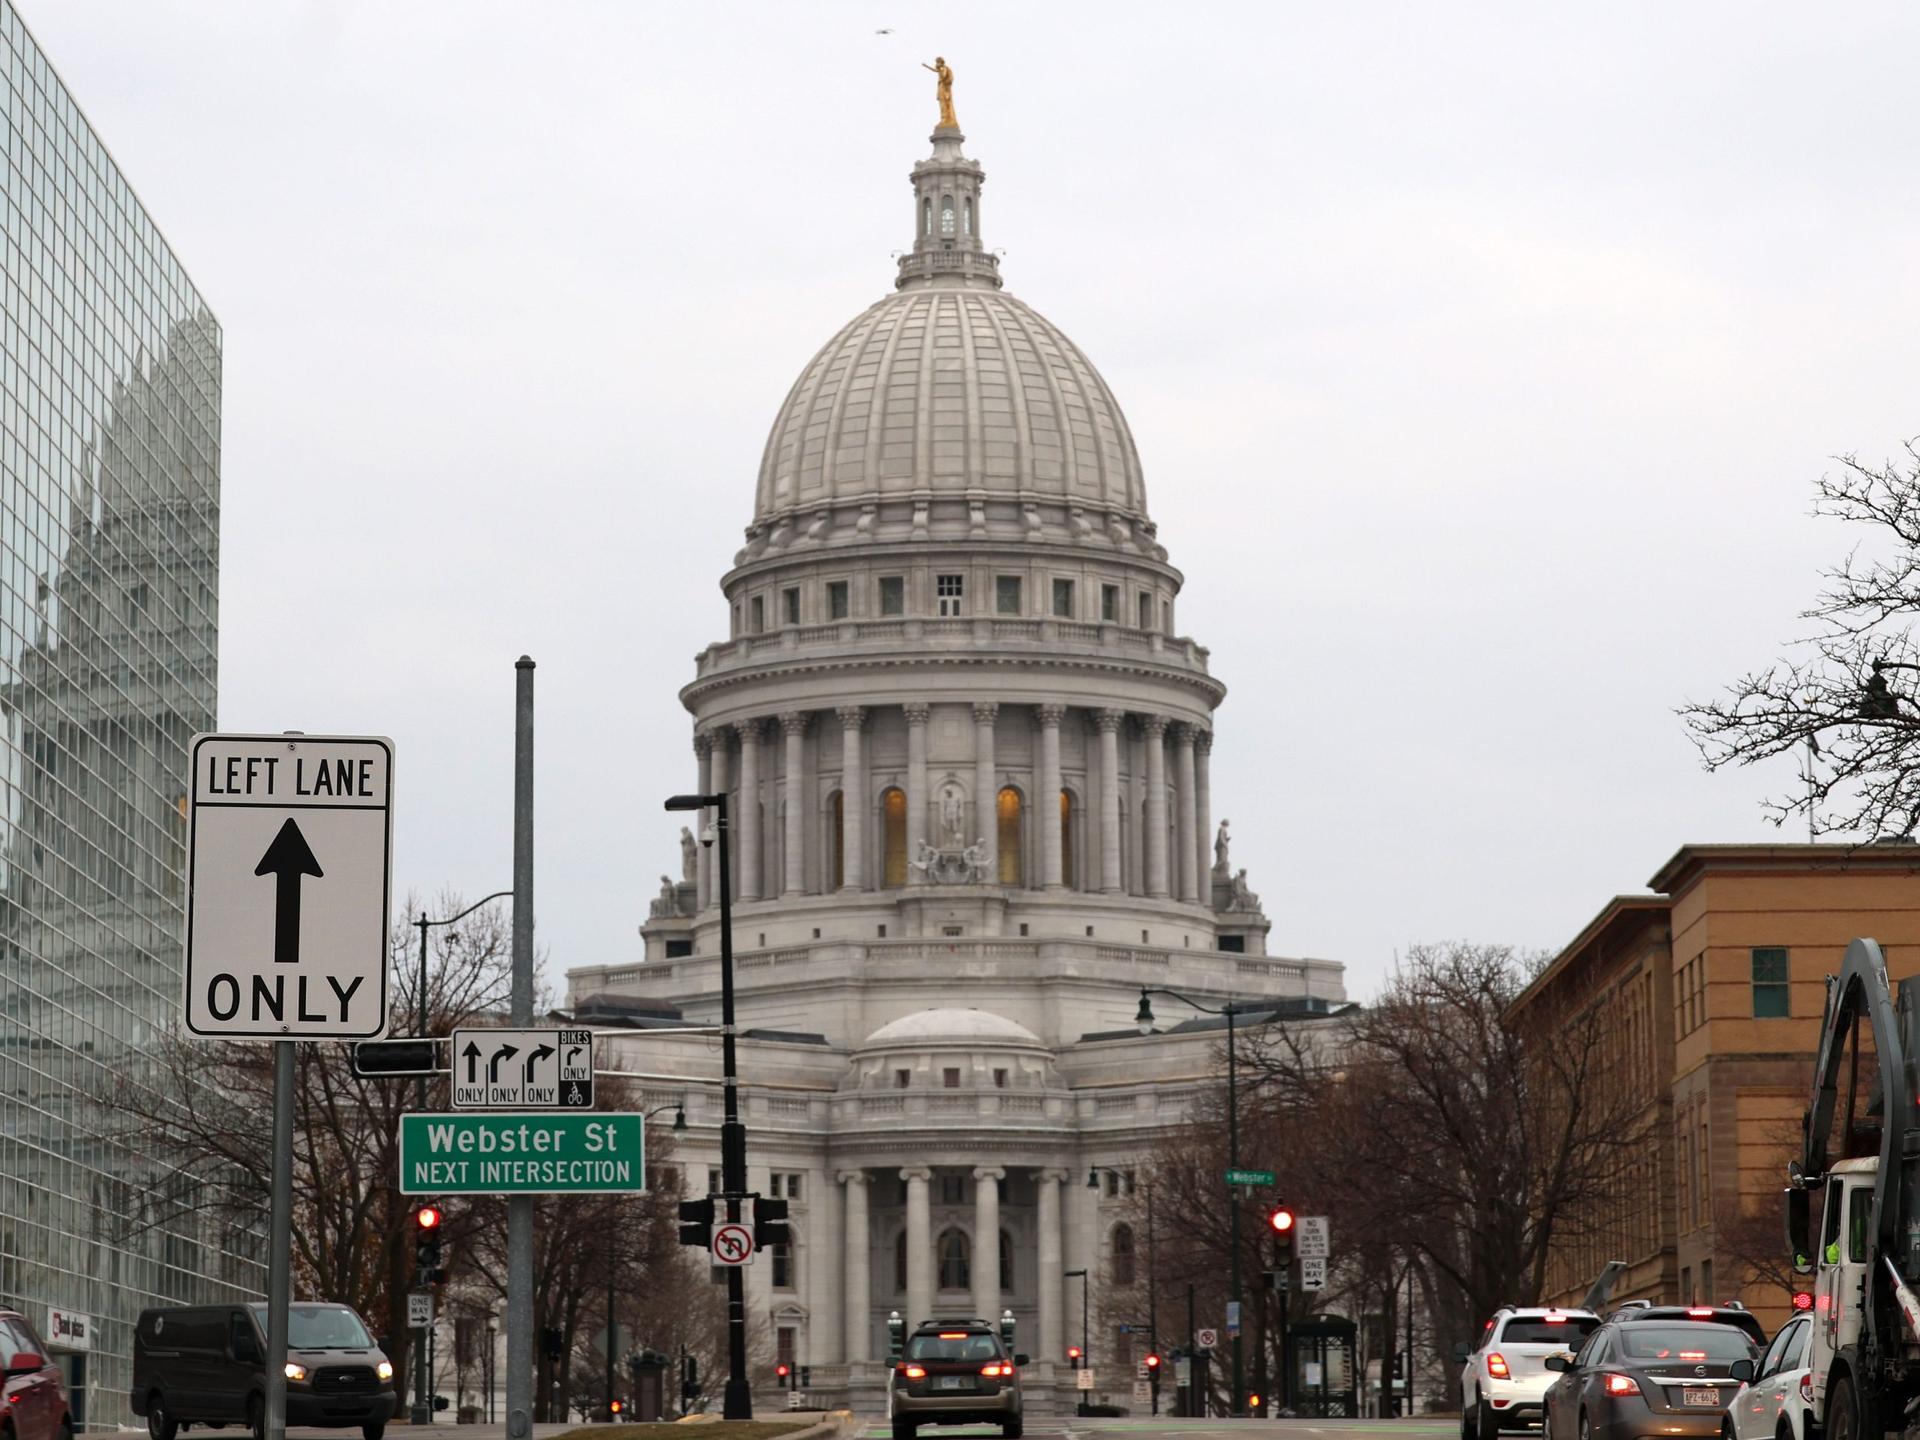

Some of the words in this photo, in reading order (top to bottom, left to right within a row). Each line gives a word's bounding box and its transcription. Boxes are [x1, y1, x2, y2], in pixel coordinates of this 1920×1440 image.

[209, 757, 279, 794] LEFT
[296, 758, 373, 797] LANE
[207, 973, 364, 1022] ONLY
[561, 1031, 590, 1044] BIKES
[563, 1067, 587, 1080] ONLY
[457, 1088, 484, 1103] ONLY
[491, 1088, 518, 1103] ONLY
[528, 1088, 555, 1103] ONLY
[427, 1124, 566, 1153] Webster
[584, 1122, 617, 1152] St
[415, 1162, 469, 1184] NEXT
[480, 1160, 630, 1183] INTERSECTION
[1232, 1172, 1266, 1182] Webster
[1304, 1261, 1323, 1270] ONE
[1304, 1270, 1323, 1279] WAY
[411, 1297, 429, 1306] ONE
[411, 1307, 429, 1315] WAY
